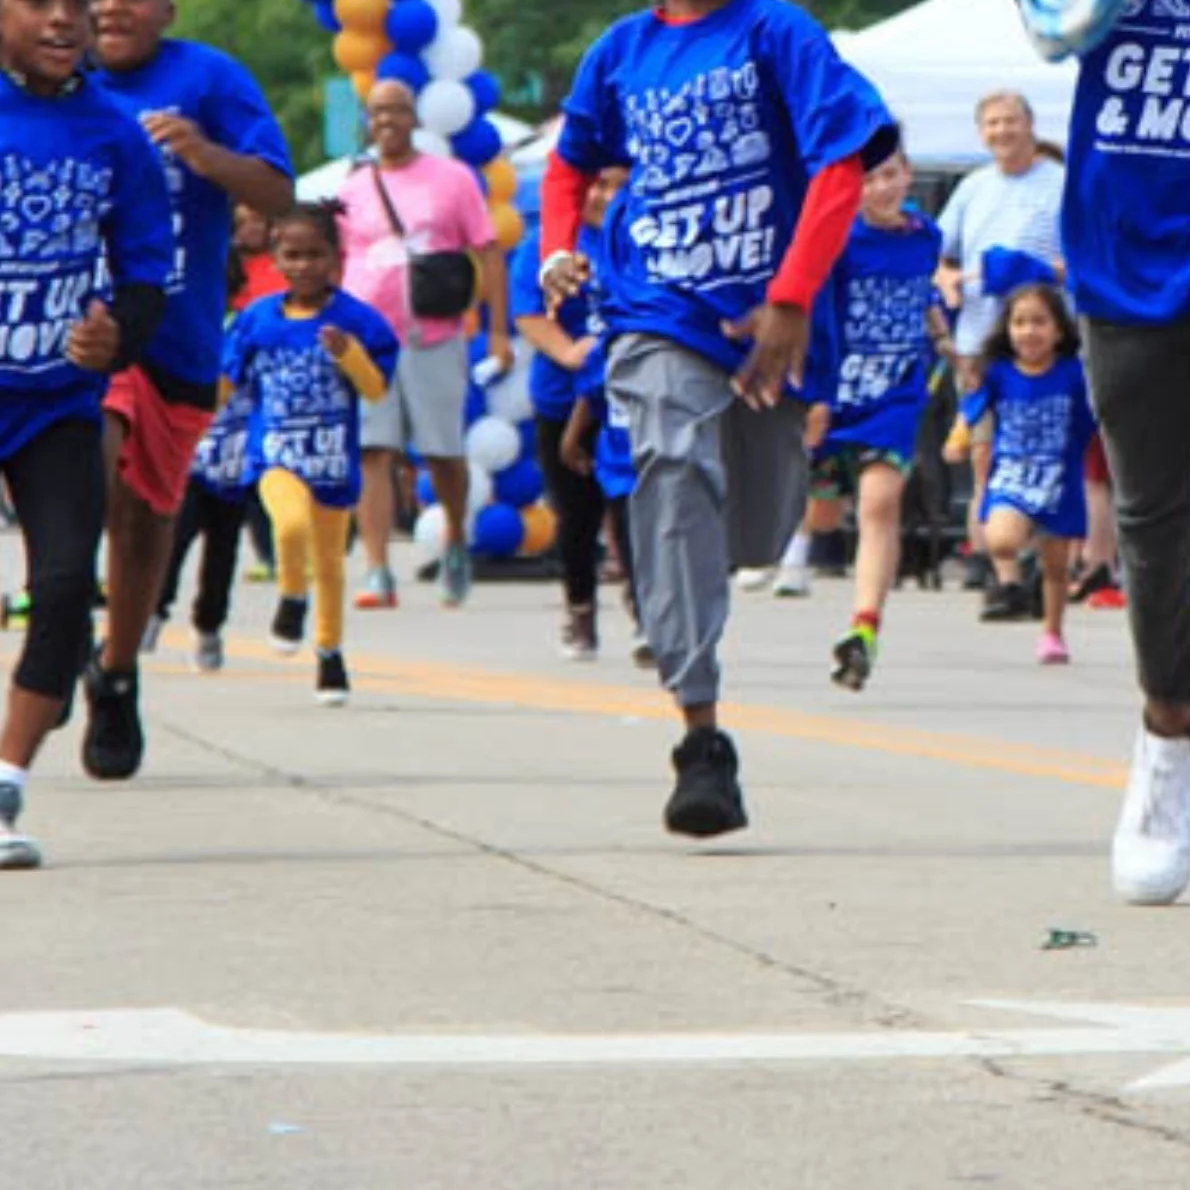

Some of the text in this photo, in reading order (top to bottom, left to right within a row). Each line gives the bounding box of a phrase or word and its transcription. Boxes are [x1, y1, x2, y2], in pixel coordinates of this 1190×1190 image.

[1095, 96, 1129, 136] &
[629, 203, 705, 249] GET
[712, 185, 773, 234] UP
